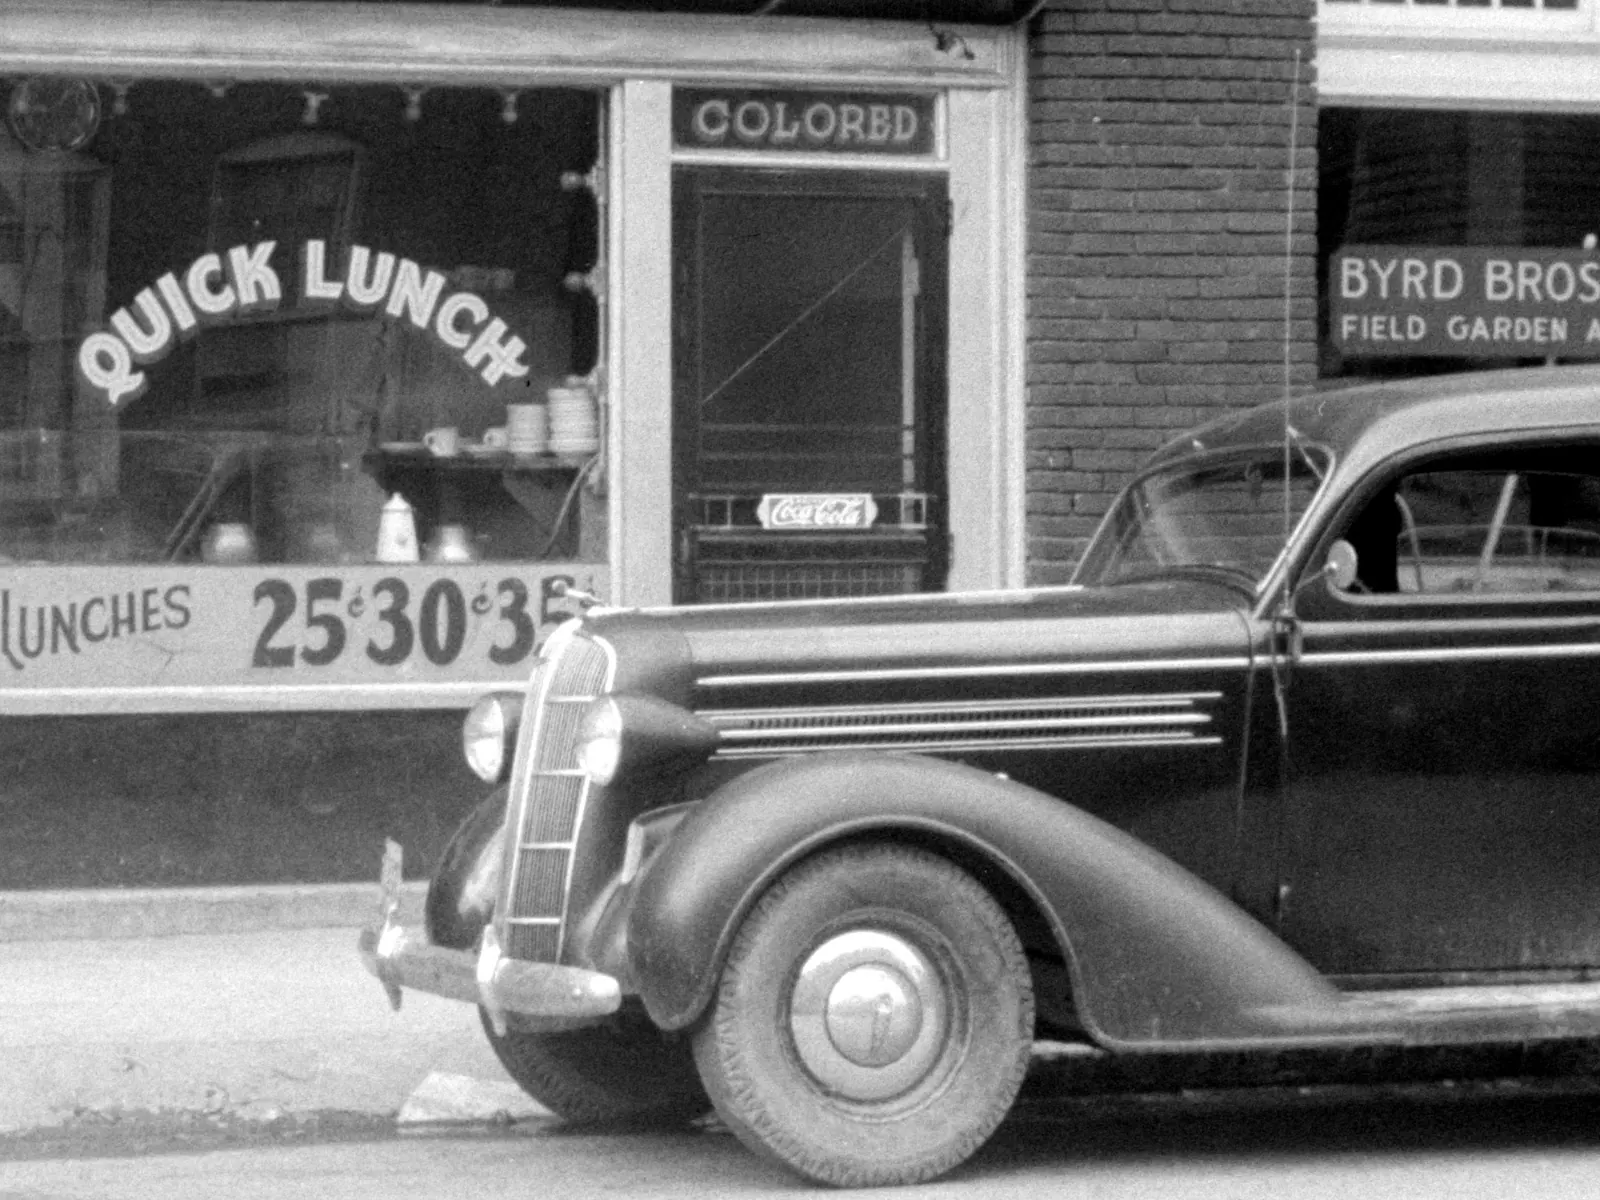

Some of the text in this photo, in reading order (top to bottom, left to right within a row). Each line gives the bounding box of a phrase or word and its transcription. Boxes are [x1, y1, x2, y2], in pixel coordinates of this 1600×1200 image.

[693, 99, 918, 143] COLORED
[1340, 256, 1600, 301] BYRD BROS
[78, 239, 529, 404] QUICK LUNCH
[1341, 314, 1427, 341] FIELD
[1447, 314, 1568, 342] GARDEN
[2, 585, 191, 670] LUNCHES
